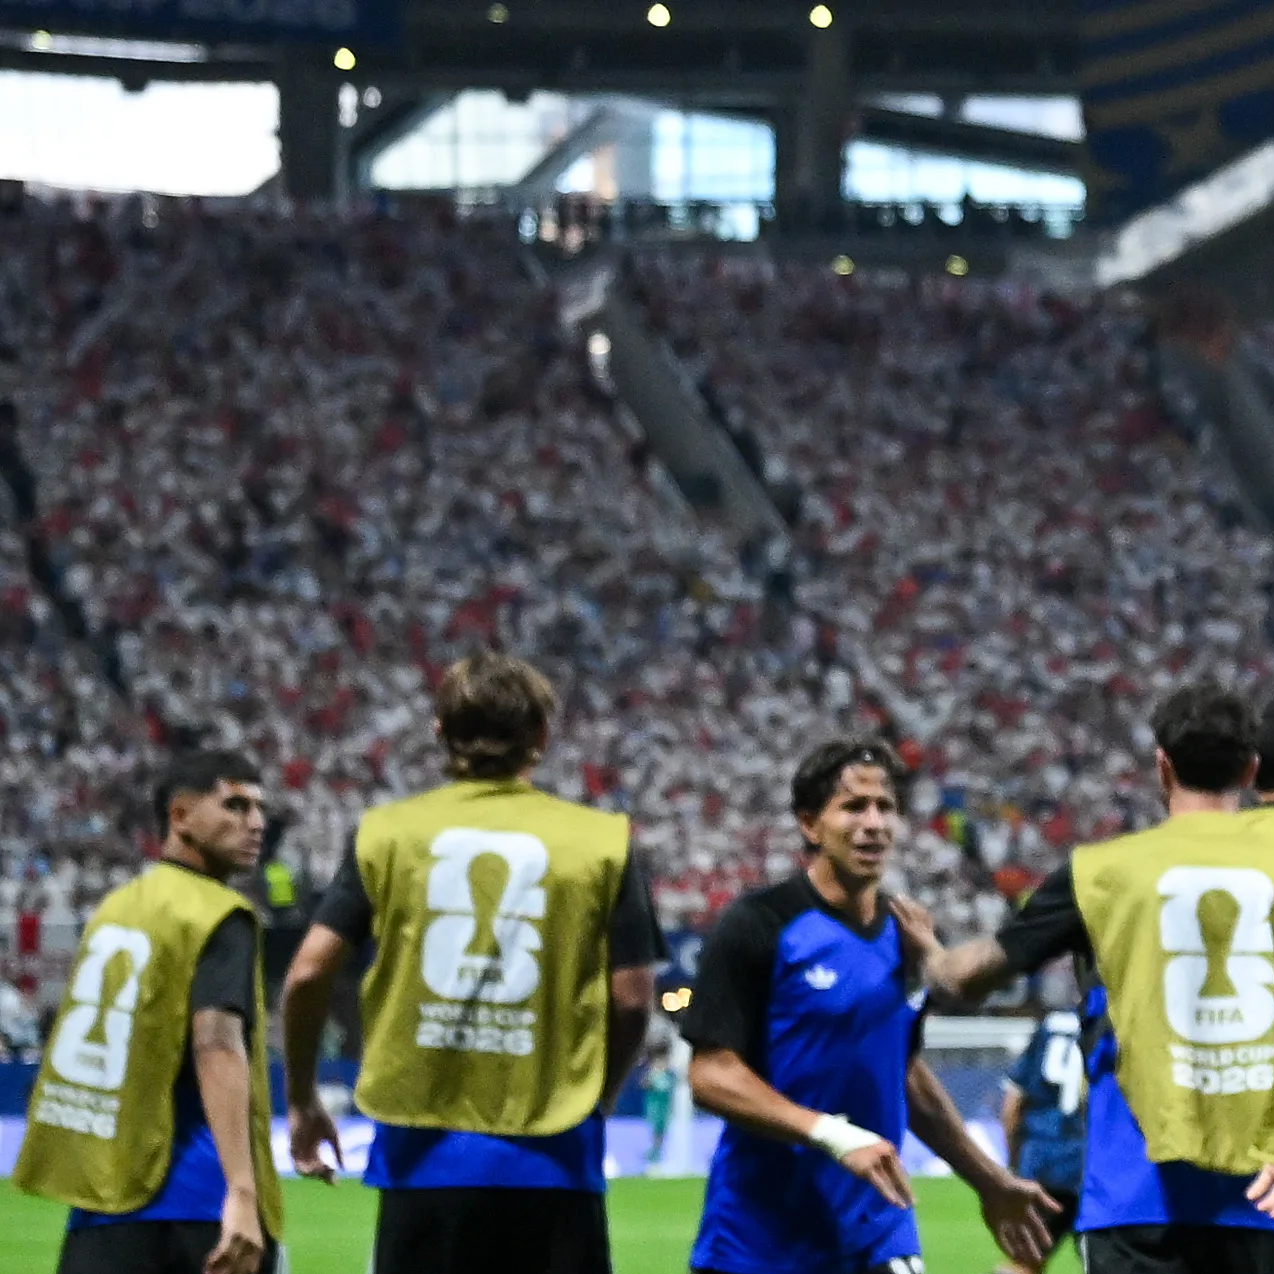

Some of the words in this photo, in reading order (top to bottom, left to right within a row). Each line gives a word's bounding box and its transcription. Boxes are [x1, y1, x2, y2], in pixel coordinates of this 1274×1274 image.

[1194, 1007, 1244, 1027] FIFA
[415, 1021, 536, 1056] 2026
[1169, 1043, 1233, 1068] WORLD
[1041, 1035, 1085, 1116] 4
